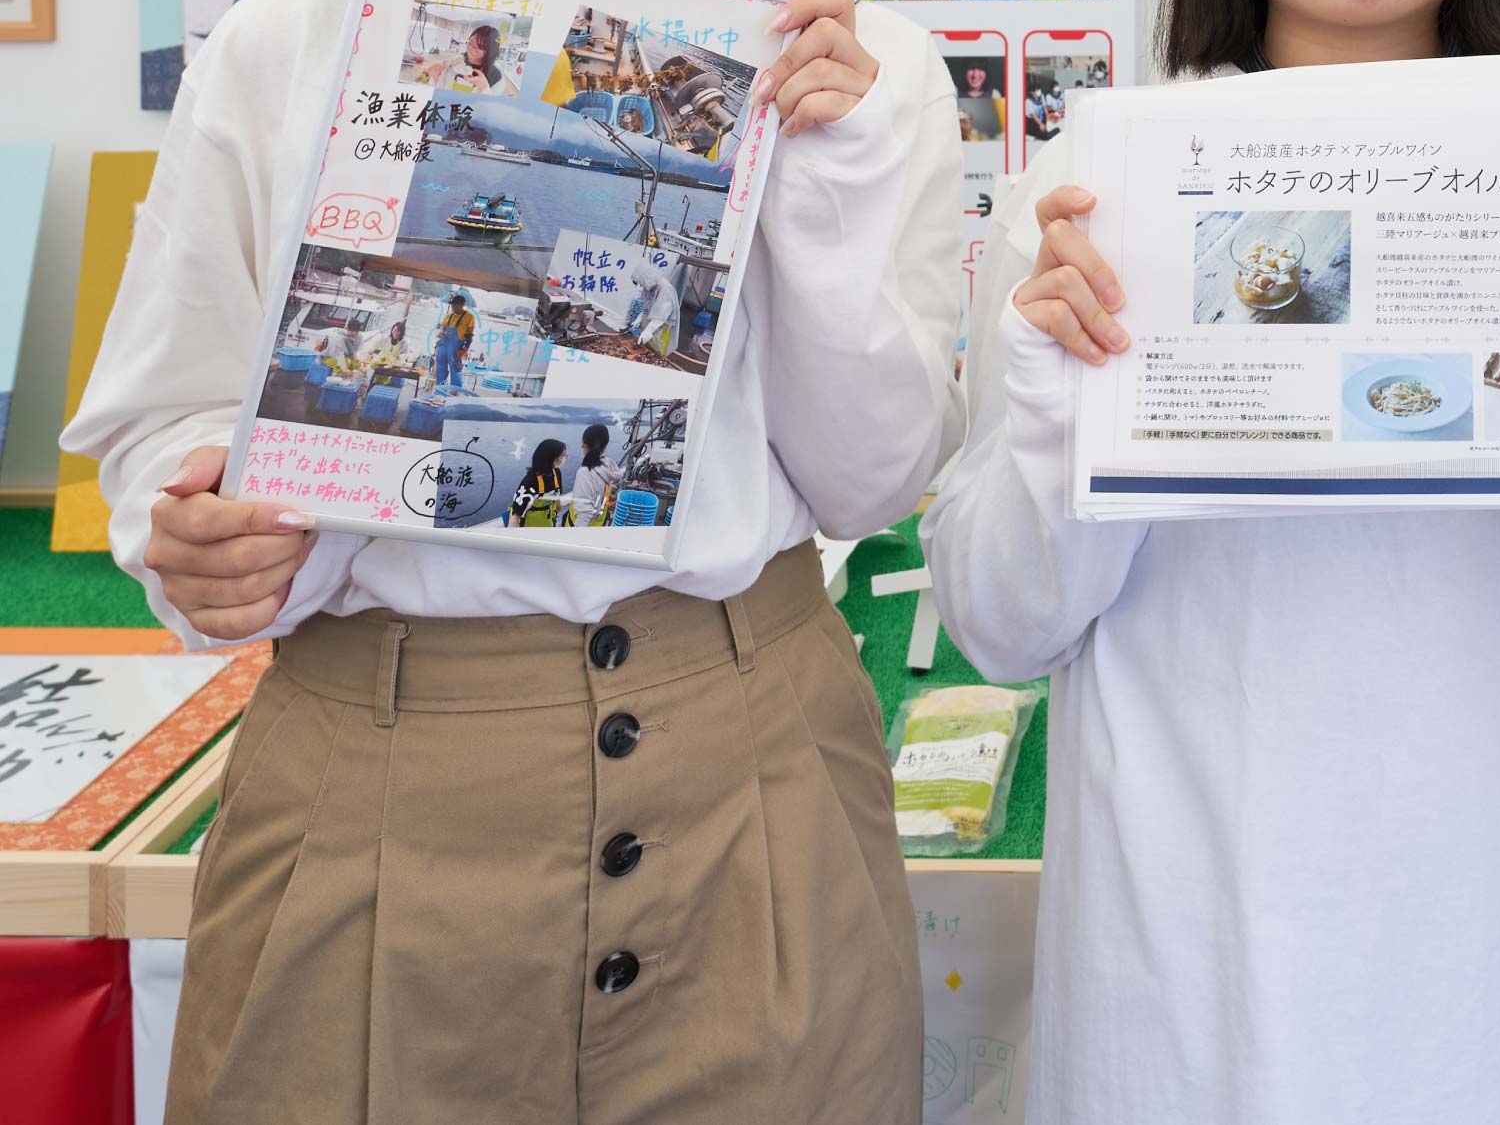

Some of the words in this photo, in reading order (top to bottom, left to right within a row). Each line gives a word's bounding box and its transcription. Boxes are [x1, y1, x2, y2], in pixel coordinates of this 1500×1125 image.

[625, 15, 740, 57] 水揚げ中
[351, 90, 476, 132] 漁業体験
[1230, 142, 1443, 159] 大船渡産ホタテ×アップルワイン
[320, 205, 384, 236] BBQ
[573, 248, 626, 271] 帆立の
[479, 327, 528, 360] 中野
[420, 462, 476, 487] 大船渡
[424, 492, 464, 514] の海
